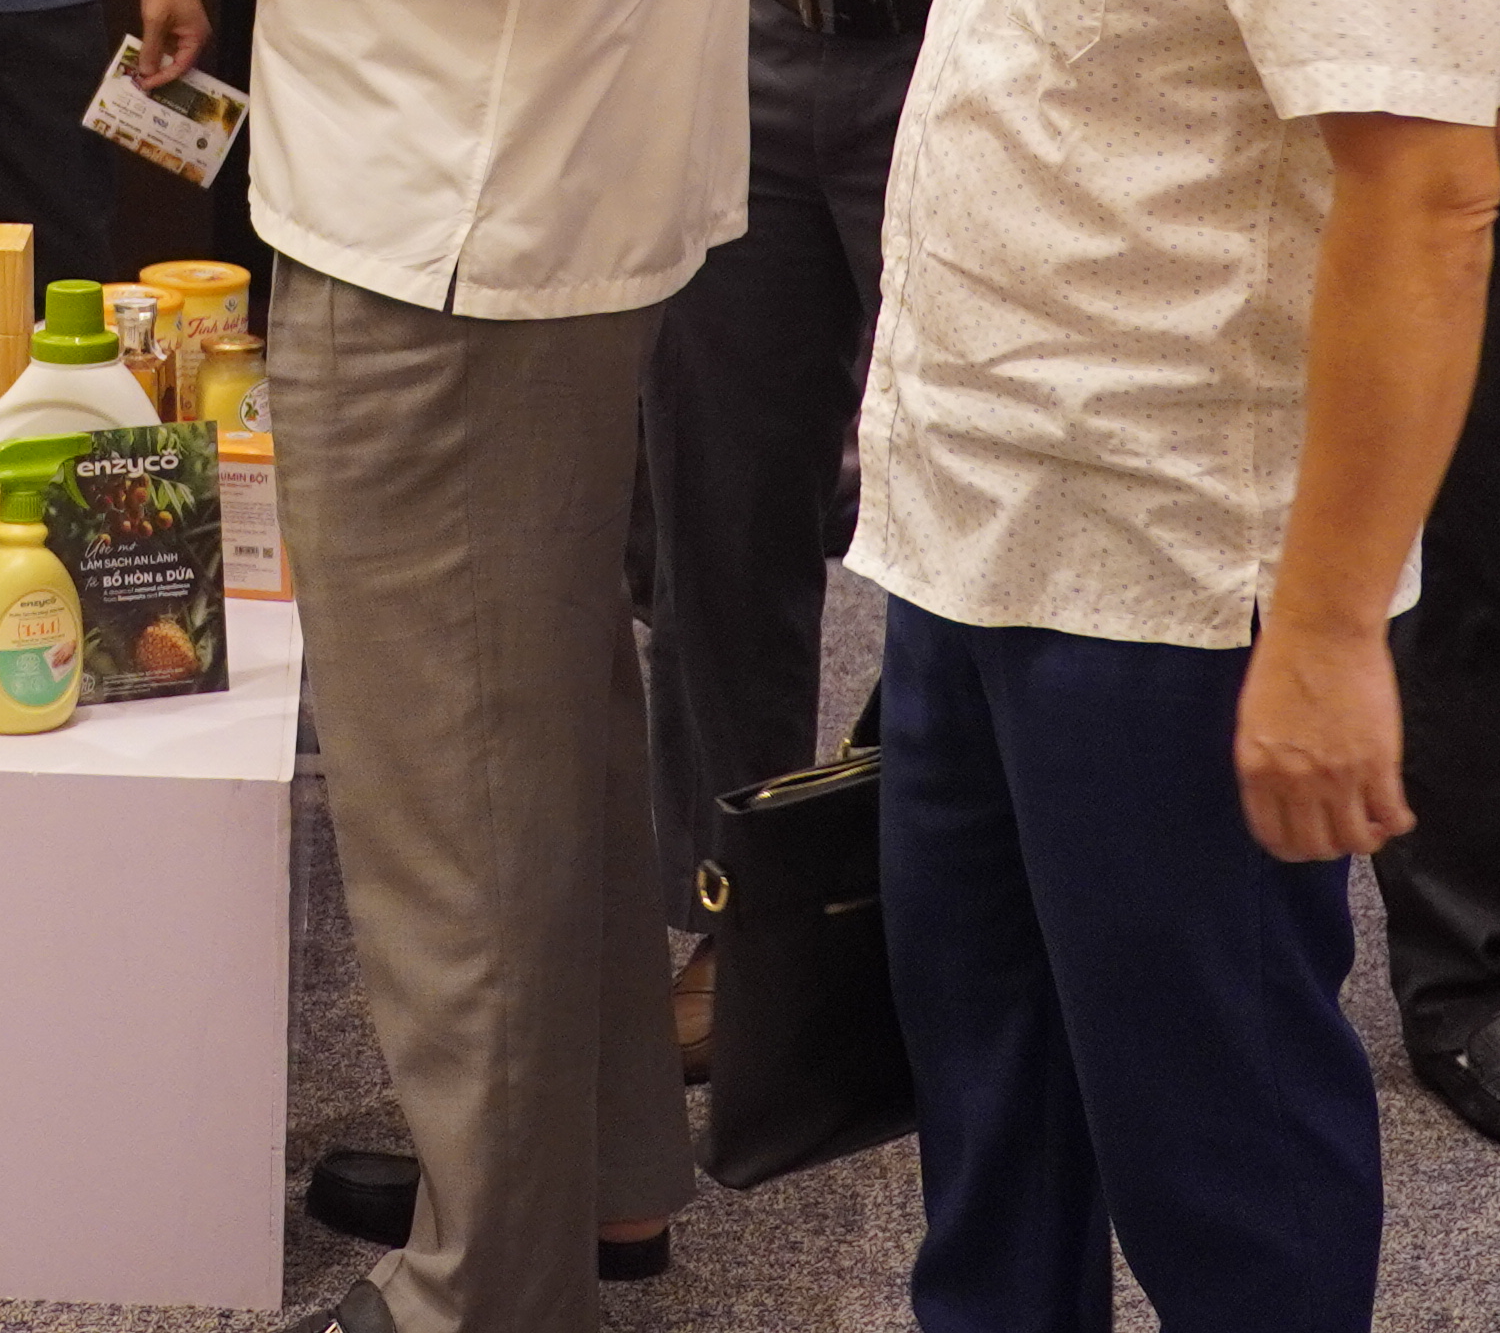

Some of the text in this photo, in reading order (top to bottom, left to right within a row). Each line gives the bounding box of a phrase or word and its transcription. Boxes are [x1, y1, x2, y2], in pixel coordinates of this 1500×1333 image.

[77, 450, 179, 478] enzyco
[133, 555, 149, 566] AN
[150, 550, 178, 564] LÀNH
[124, 568, 153, 585] HÒN
[156, 574, 163, 582] &
[166, 566, 195, 581] DỨA
[20, 597, 57, 607] enzyco
